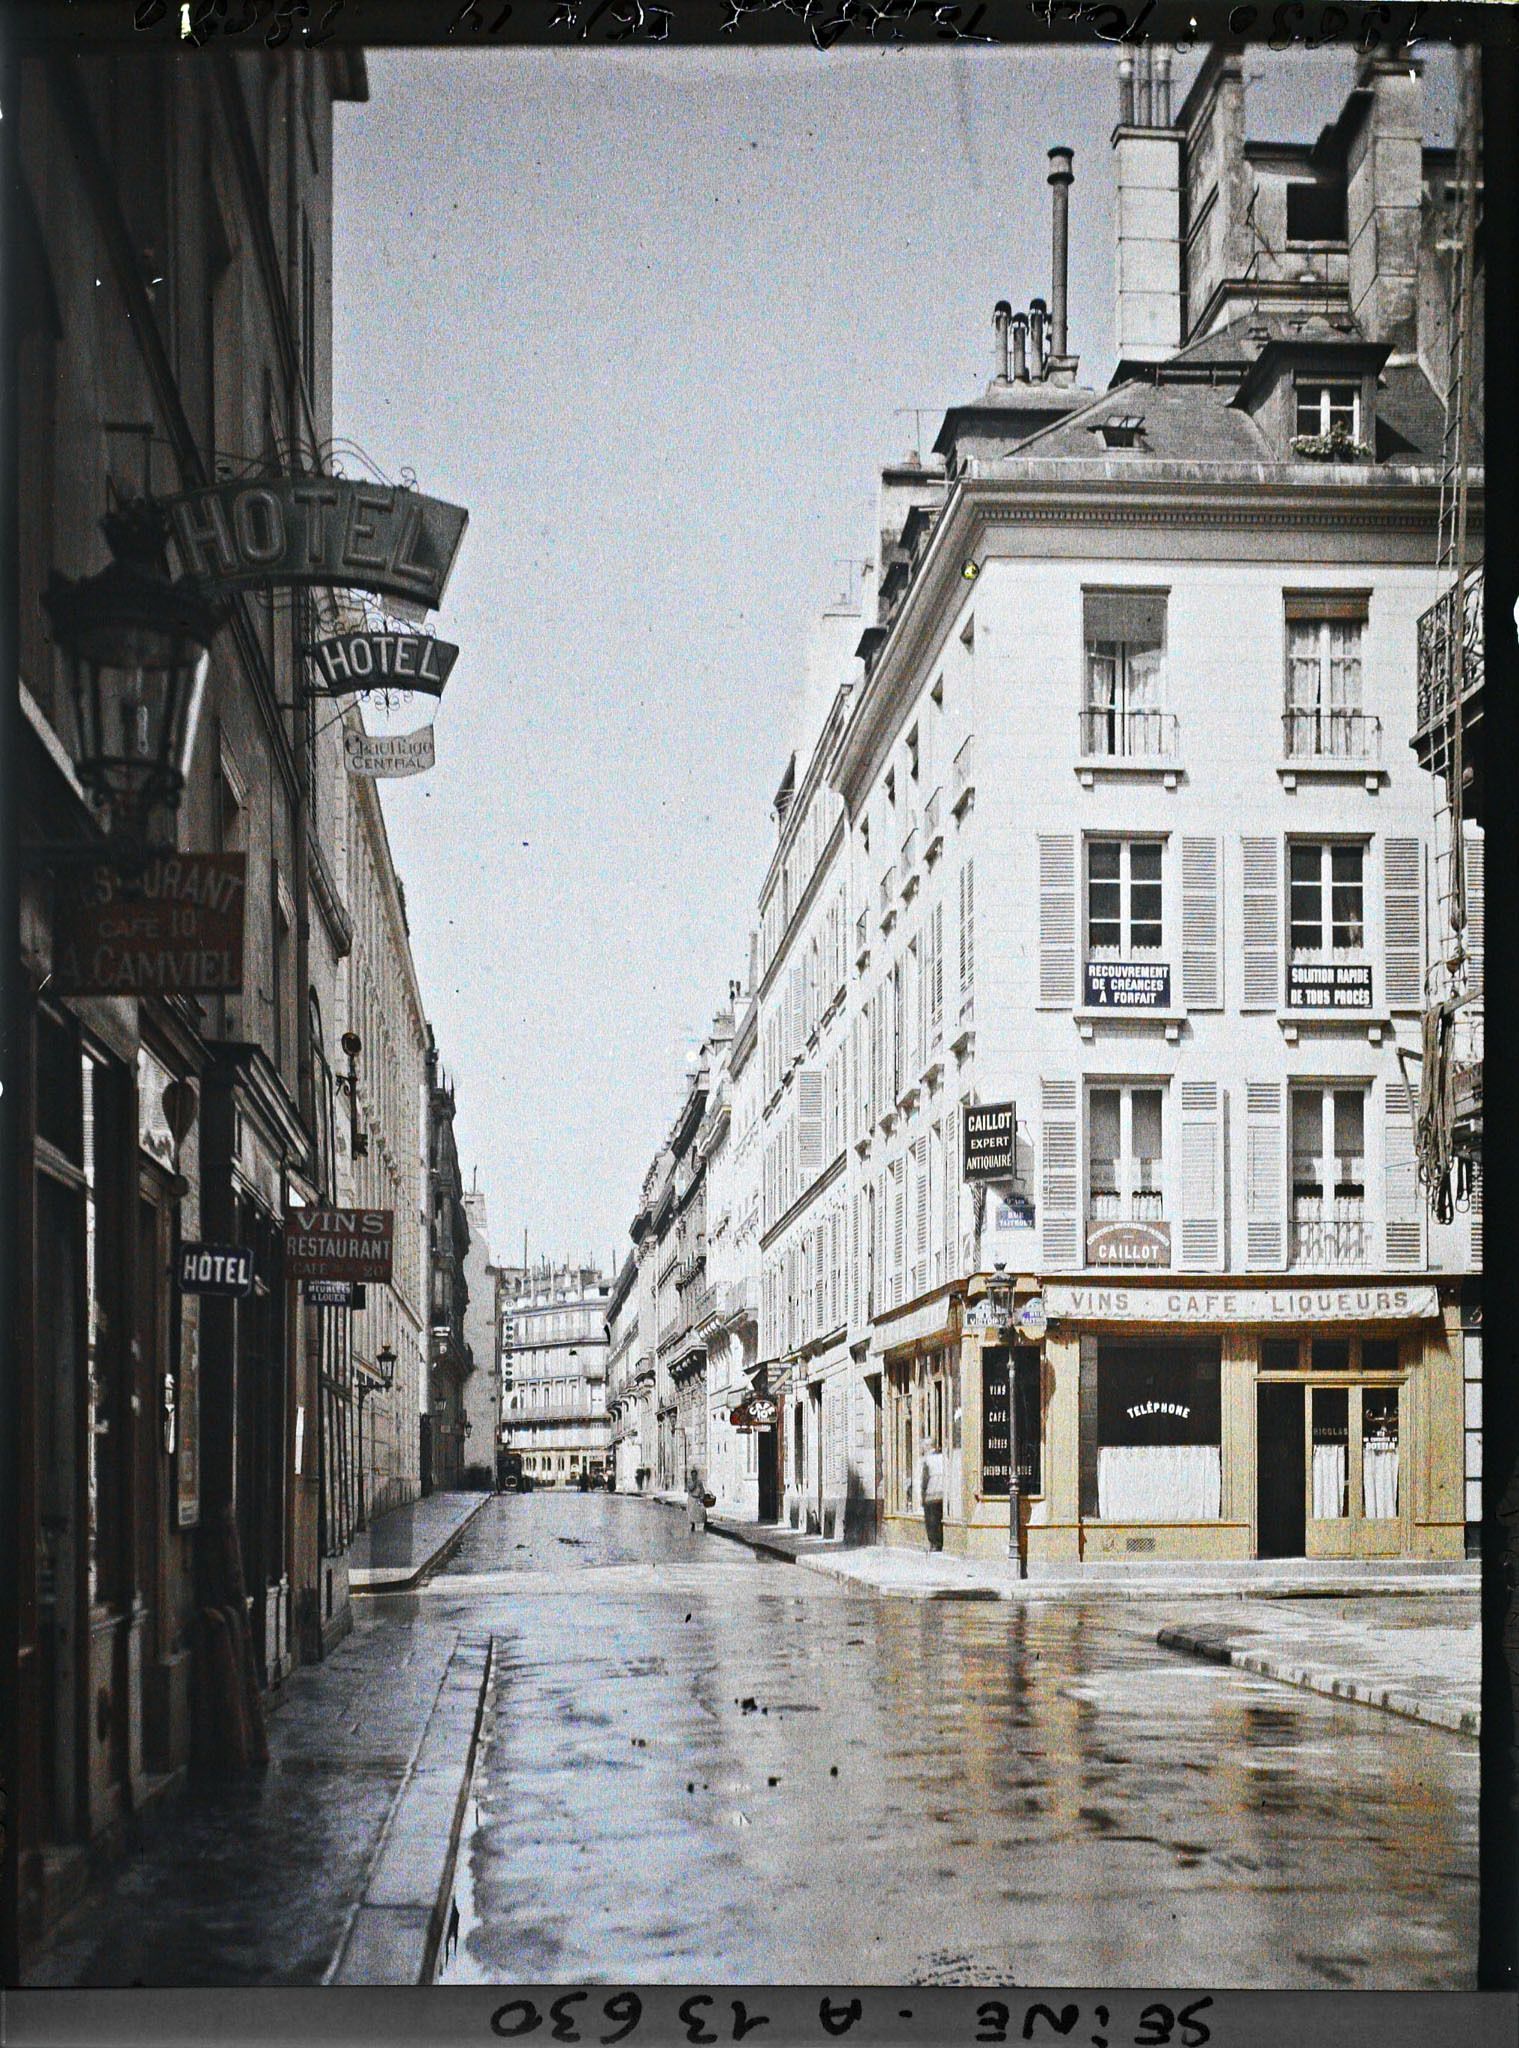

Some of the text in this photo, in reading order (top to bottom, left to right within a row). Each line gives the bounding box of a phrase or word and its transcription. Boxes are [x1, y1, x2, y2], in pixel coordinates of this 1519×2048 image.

[173, 489, 437, 584] HOTEL
[321, 636, 441, 683] HOTEL
[352, 755, 426, 769] CENTRAL
[1088, 965, 1168, 978] RECOUVREMENT
[1291, 968, 1369, 984] SOLUTION RAPIDE
[1092, 977, 1163, 991] DE CRÉANCES
[1114, 991, 1156, 1004] FORFAIT
[1291, 989, 1303, 1004] DE
[1305, 989, 1330, 1005] TOUS
[968, 1112, 1012, 1132] CAILLOT
[971, 1136, 1009, 1149] EXPERT
[294, 1212, 385, 1234] VINS
[287, 1236, 391, 1260] RESTAURANT
[1098, 1245, 1159, 1259] CAILLOT
[183, 1251, 249, 1285] HÔTEL
[318, 1293, 346, 1303] LOUER
[1070, 1291, 1129, 1310] VINS
[1272, 1290, 1410, 1313] LIQUEURS
[989, 1384, 1007, 1395] VINS
[988, 1410, 1007, 1422] CAFÉ
